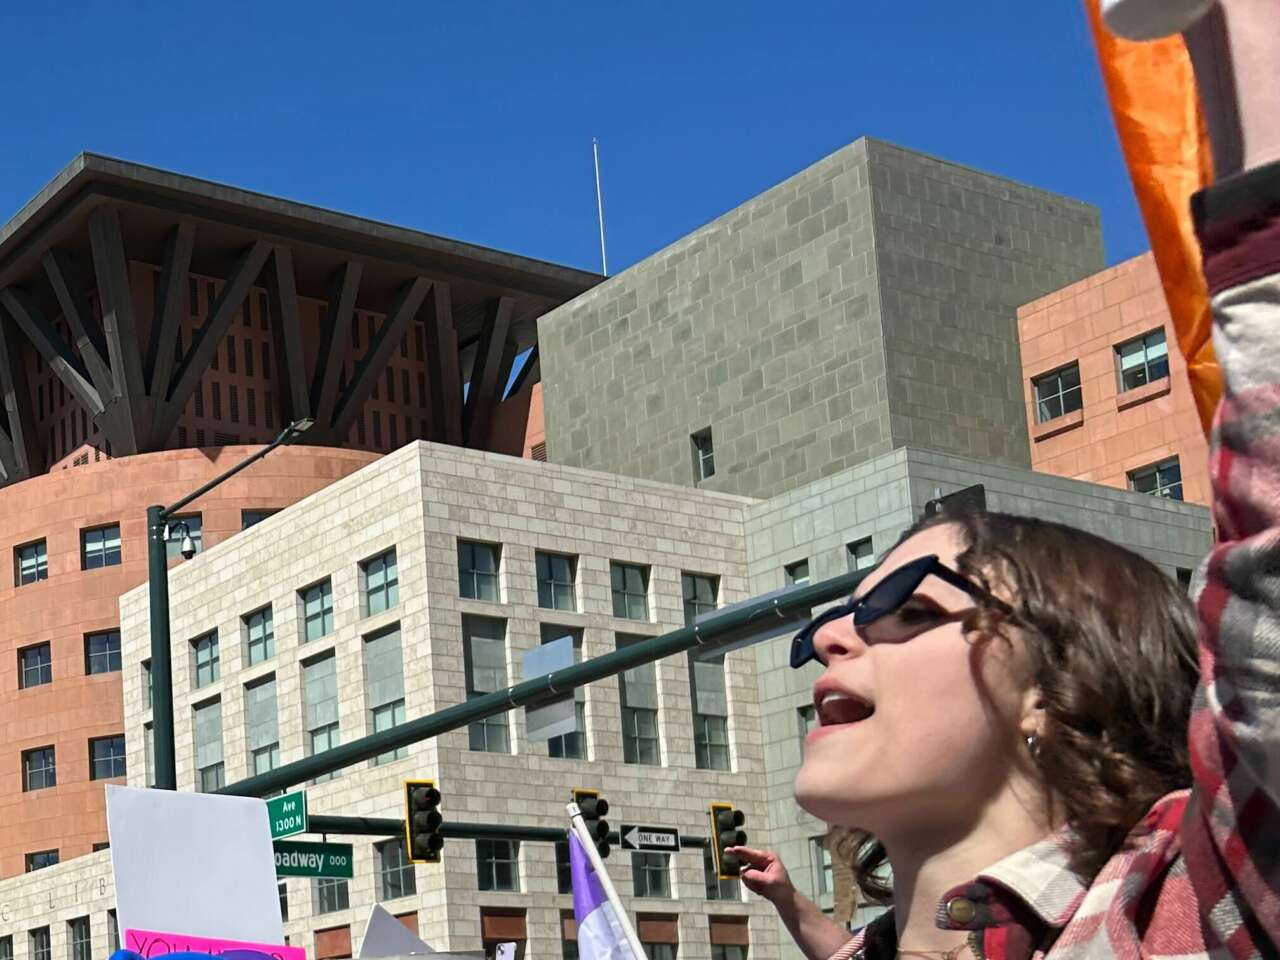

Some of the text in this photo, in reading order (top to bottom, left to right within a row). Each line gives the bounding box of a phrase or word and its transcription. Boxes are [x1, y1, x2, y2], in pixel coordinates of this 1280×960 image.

[282, 800, 296, 813] Ave
[275, 815, 301, 832] 1300 N
[638, 833, 671, 843] ONE WAY
[274, 851, 325, 873] oadway
[48, 877, 106, 910] LIB
